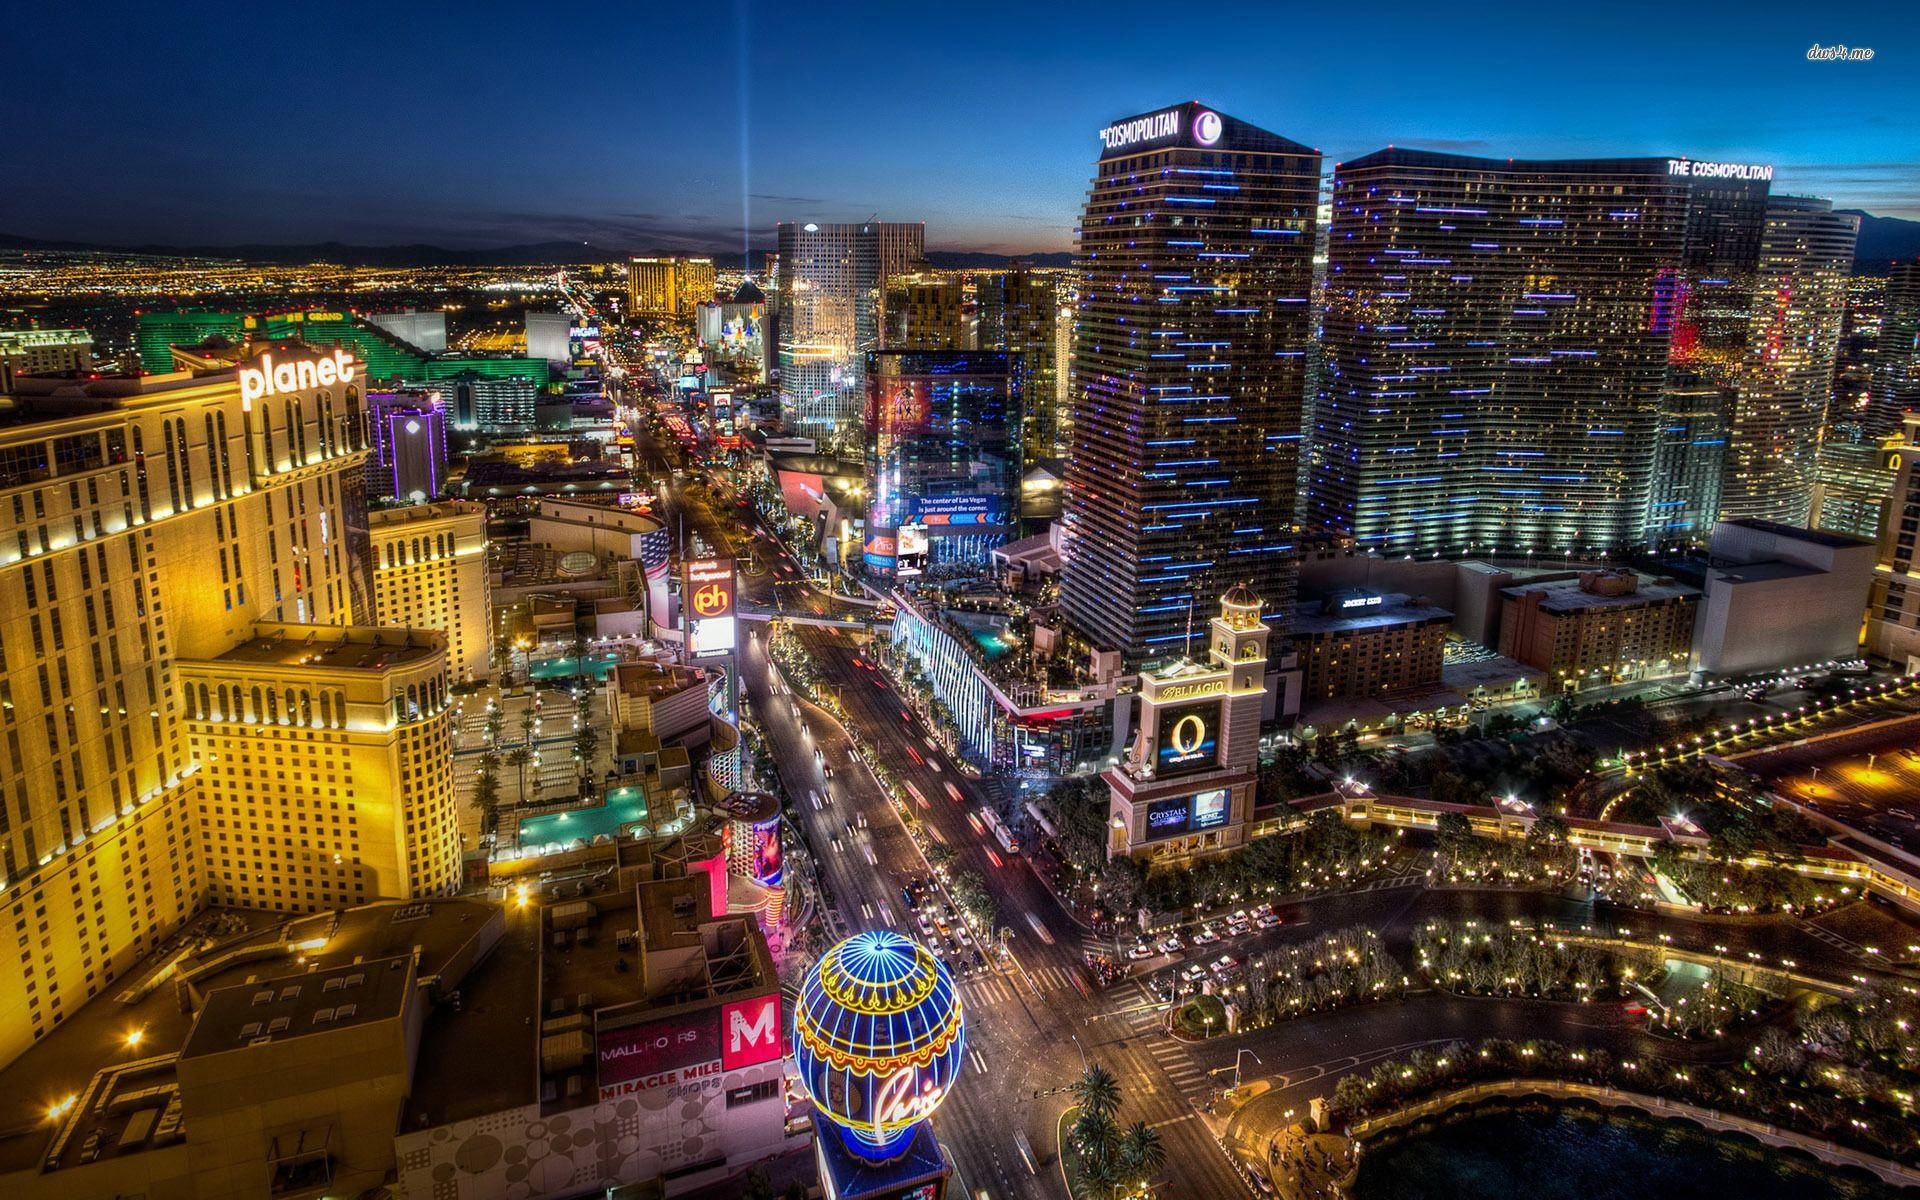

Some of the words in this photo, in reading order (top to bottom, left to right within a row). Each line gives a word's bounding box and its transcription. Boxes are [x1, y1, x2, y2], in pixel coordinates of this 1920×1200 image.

[1106, 111, 1178, 148] COSMOPOLITAN
[1668, 160, 1691, 176] THE
[1692, 161, 1773, 180] COSMOPOLITAN
[308, 312, 343, 321] GRAND
[570, 327, 599, 337] MGM
[240, 349, 355, 412] planet
[698, 584, 728, 613] ph
[1160, 681, 1224, 699] BELLAGIO
[1149, 807, 1187, 820] CRYSTALS
[730, 1002, 775, 1053] M
[602, 1044, 642, 1062] MALL
[601, 1072, 676, 1100] MIRACLE
[684, 1061, 720, 1080] MILE
[668, 1077, 722, 1099] SHOPS
[874, 1066, 942, 1145] Paris
